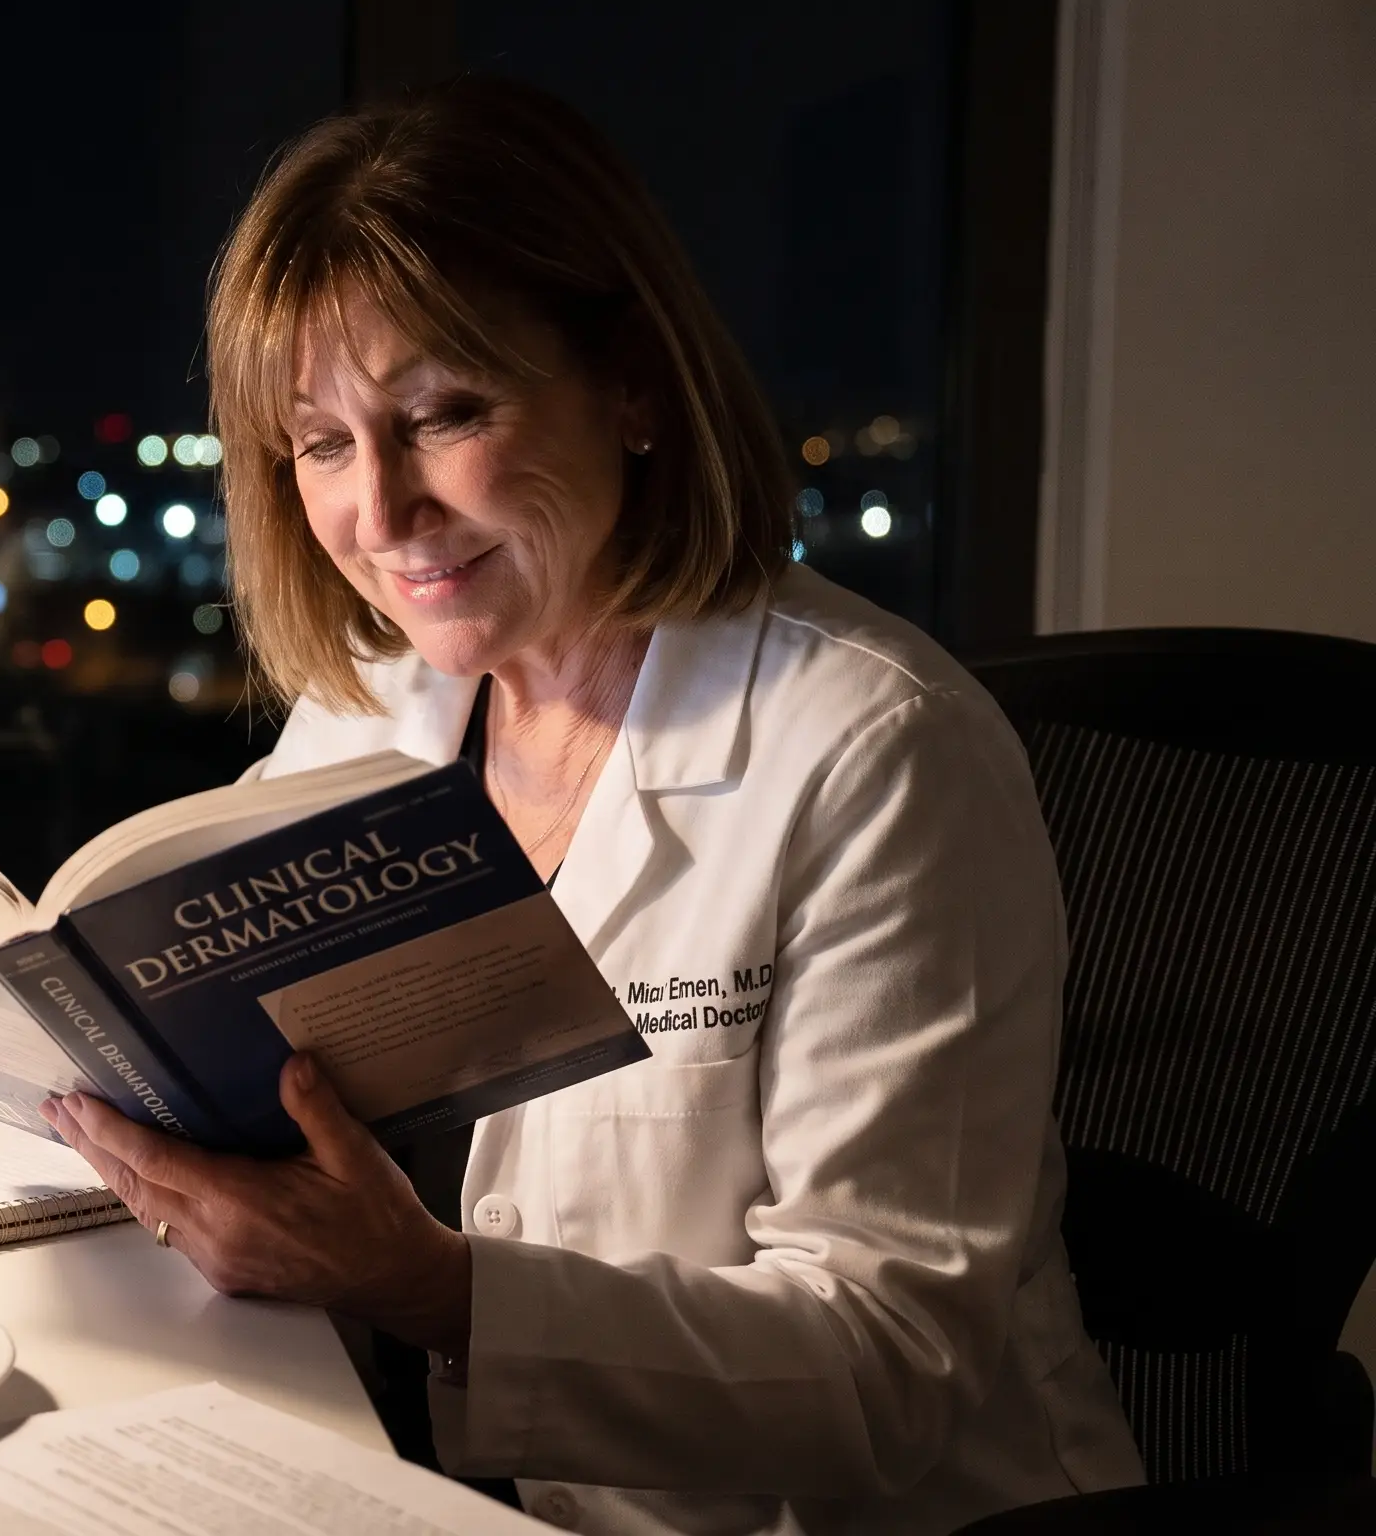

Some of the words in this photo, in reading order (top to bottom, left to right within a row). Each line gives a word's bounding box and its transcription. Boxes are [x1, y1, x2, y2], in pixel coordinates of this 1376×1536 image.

[125, 832, 484, 989] DERMATOLOGY
[173, 830, 401, 930] CLINICAL
[40, 977, 106, 1043] CLINICAL
[635, 1007, 698, 1034] Medical
[703, 1000, 767, 1029] Doctor
